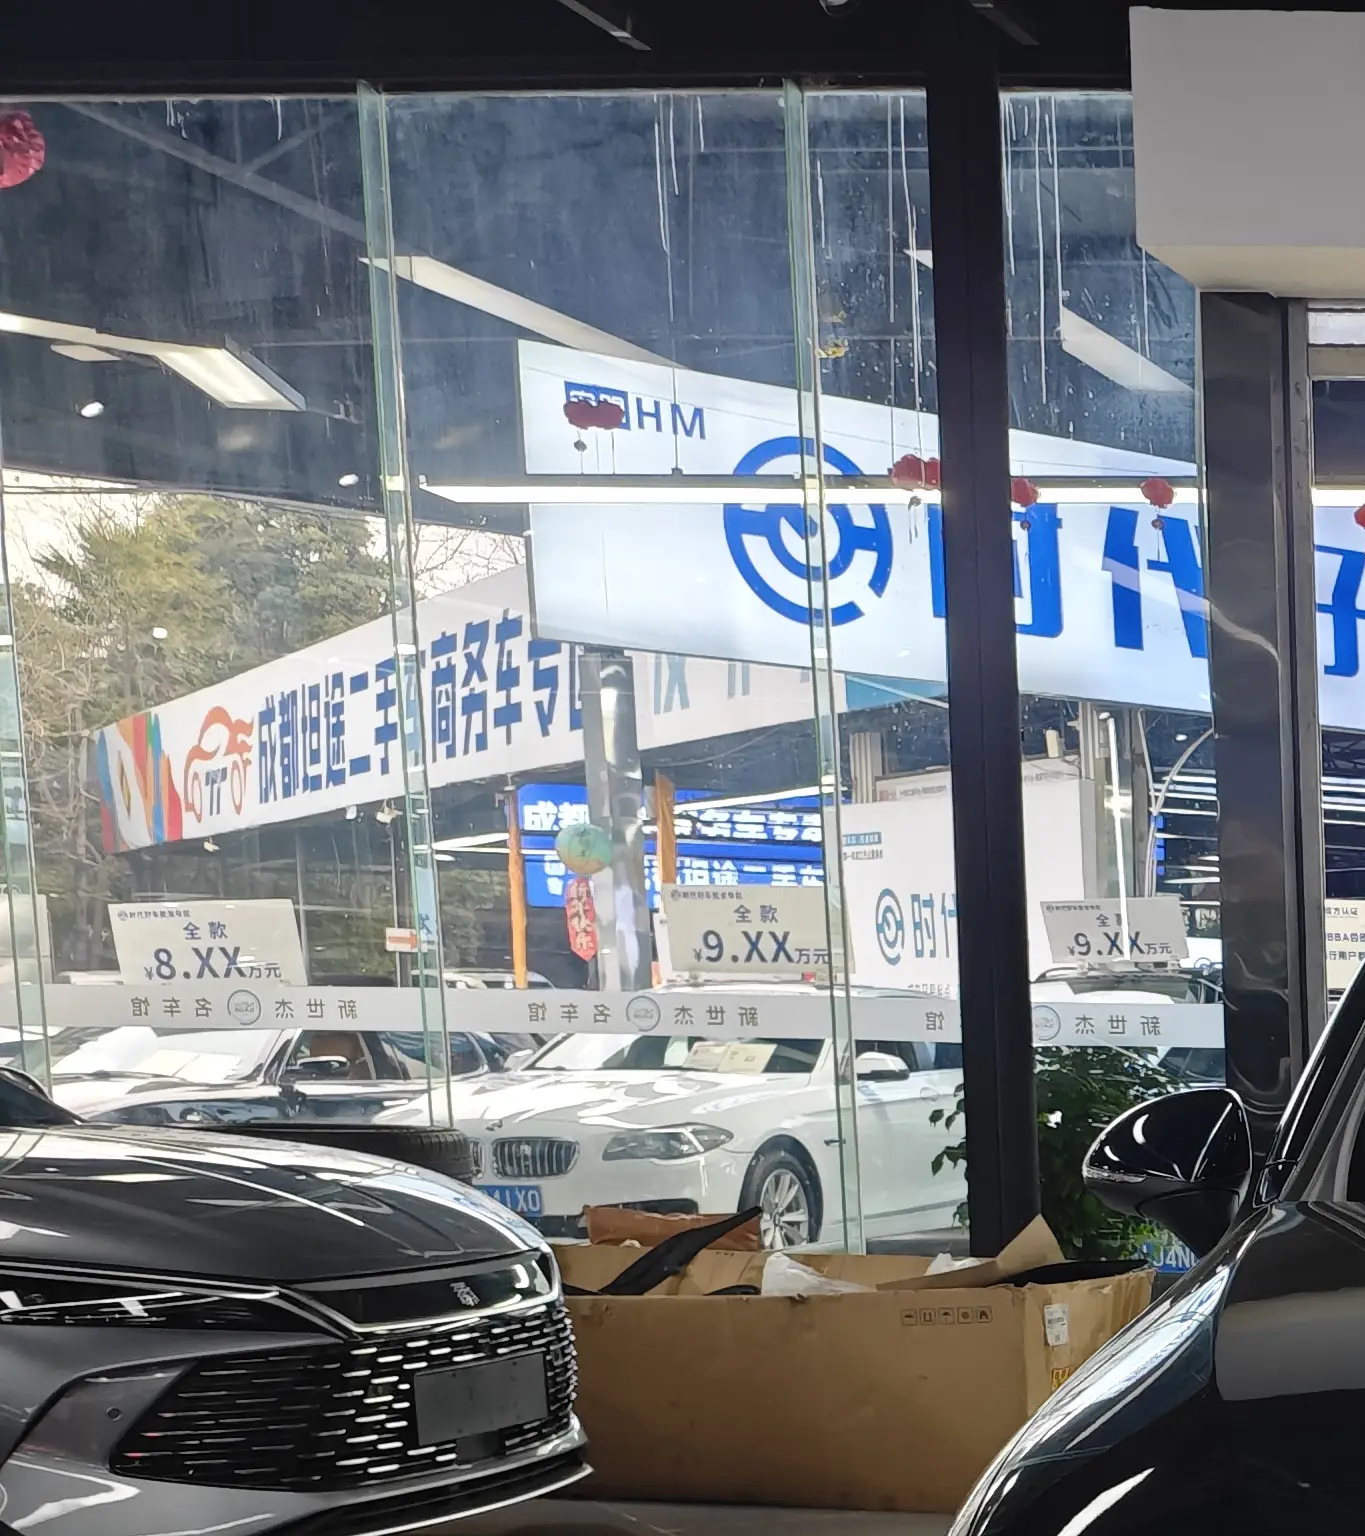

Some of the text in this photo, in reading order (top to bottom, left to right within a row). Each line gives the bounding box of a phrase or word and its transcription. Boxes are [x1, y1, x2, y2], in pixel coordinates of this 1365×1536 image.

[635, 396, 706, 440] HM
[733, 905, 779, 923] 全款
[183, 922, 228, 940] 全款
